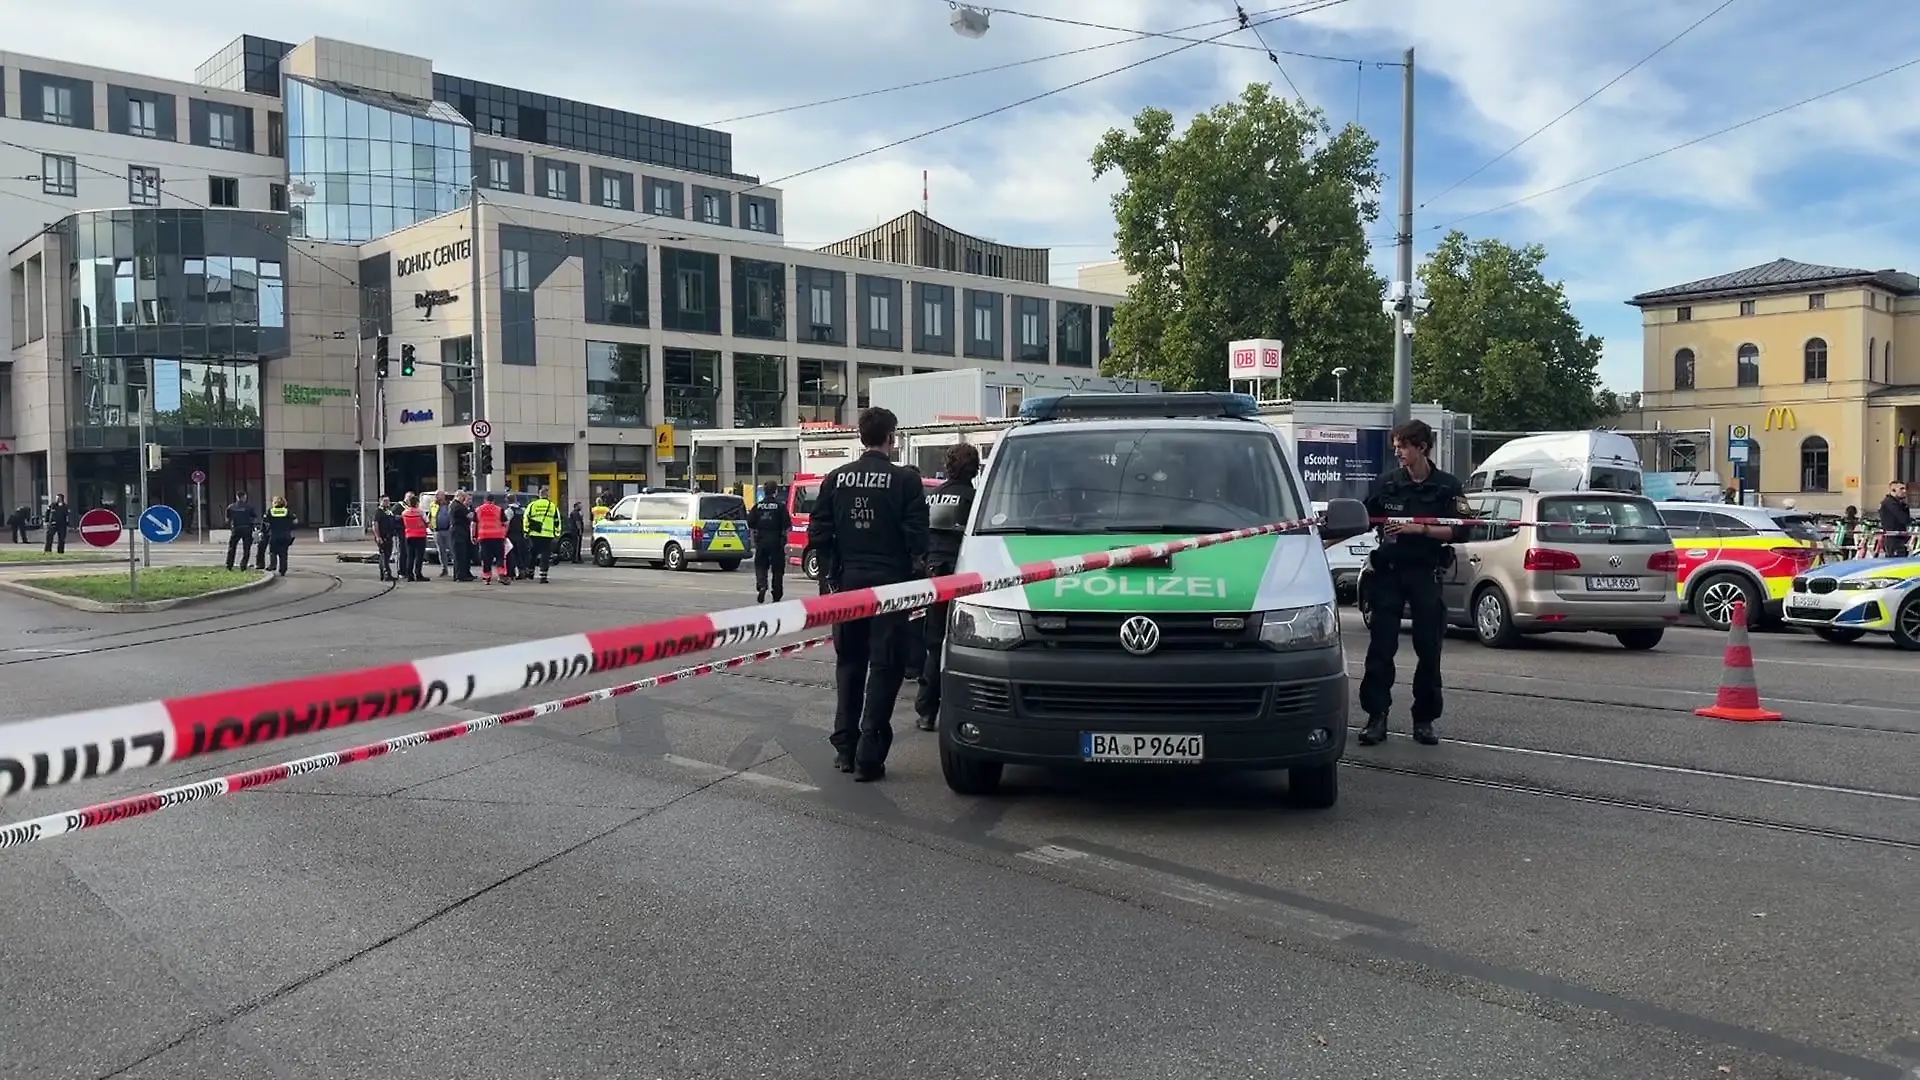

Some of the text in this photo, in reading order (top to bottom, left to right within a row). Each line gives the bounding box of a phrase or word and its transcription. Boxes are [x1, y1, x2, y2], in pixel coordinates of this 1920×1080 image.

[397, 251, 431, 277] BOHUS
[1236, 351, 1254, 366] DB
[1264, 350, 1278, 366] DB
[475, 425, 488, 434] 50
[1304, 453, 1339, 465] eScooter
[836, 471, 892, 489] POLIZEI
[1304, 470, 1341, 483] Parkplatz
[757, 502, 778, 511] POLIZEI
[854, 497, 869, 508] BY
[925, 494, 960, 506] POLIZEI
[850, 509, 874, 520] 5411
[1054, 575, 1227, 598] POLIZEI
[1094, 735, 1200, 756] BA P 9640
[0, 823, 42, 849] UNG
